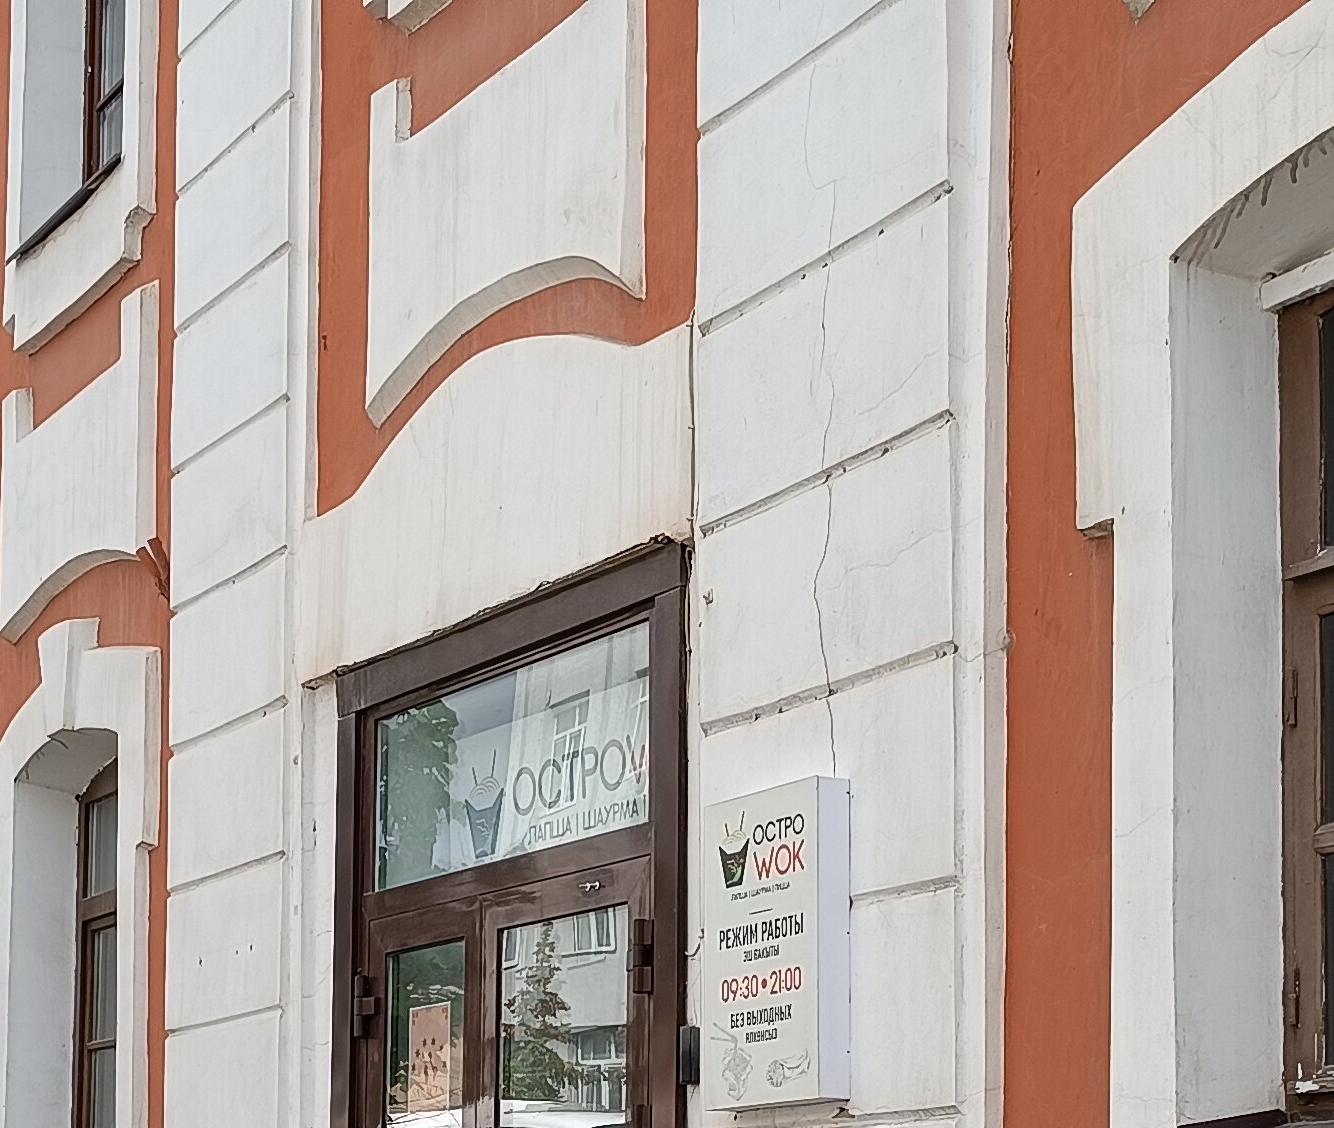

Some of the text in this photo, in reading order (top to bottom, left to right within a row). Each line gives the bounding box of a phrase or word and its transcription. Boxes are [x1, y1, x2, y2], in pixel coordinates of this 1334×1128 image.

[512, 738, 627, 817] ОСТРО
[527, 798, 640, 846] ЛАПША ШАУРМА
[753, 813, 805, 845] ОСТРО
[753, 839, 805, 880] WOK
[719, 912, 804, 951] РЕЖИМ РАБОТЫ
[730, 1003, 792, 1029] БЕЗ ВЫХОДНЫХ
